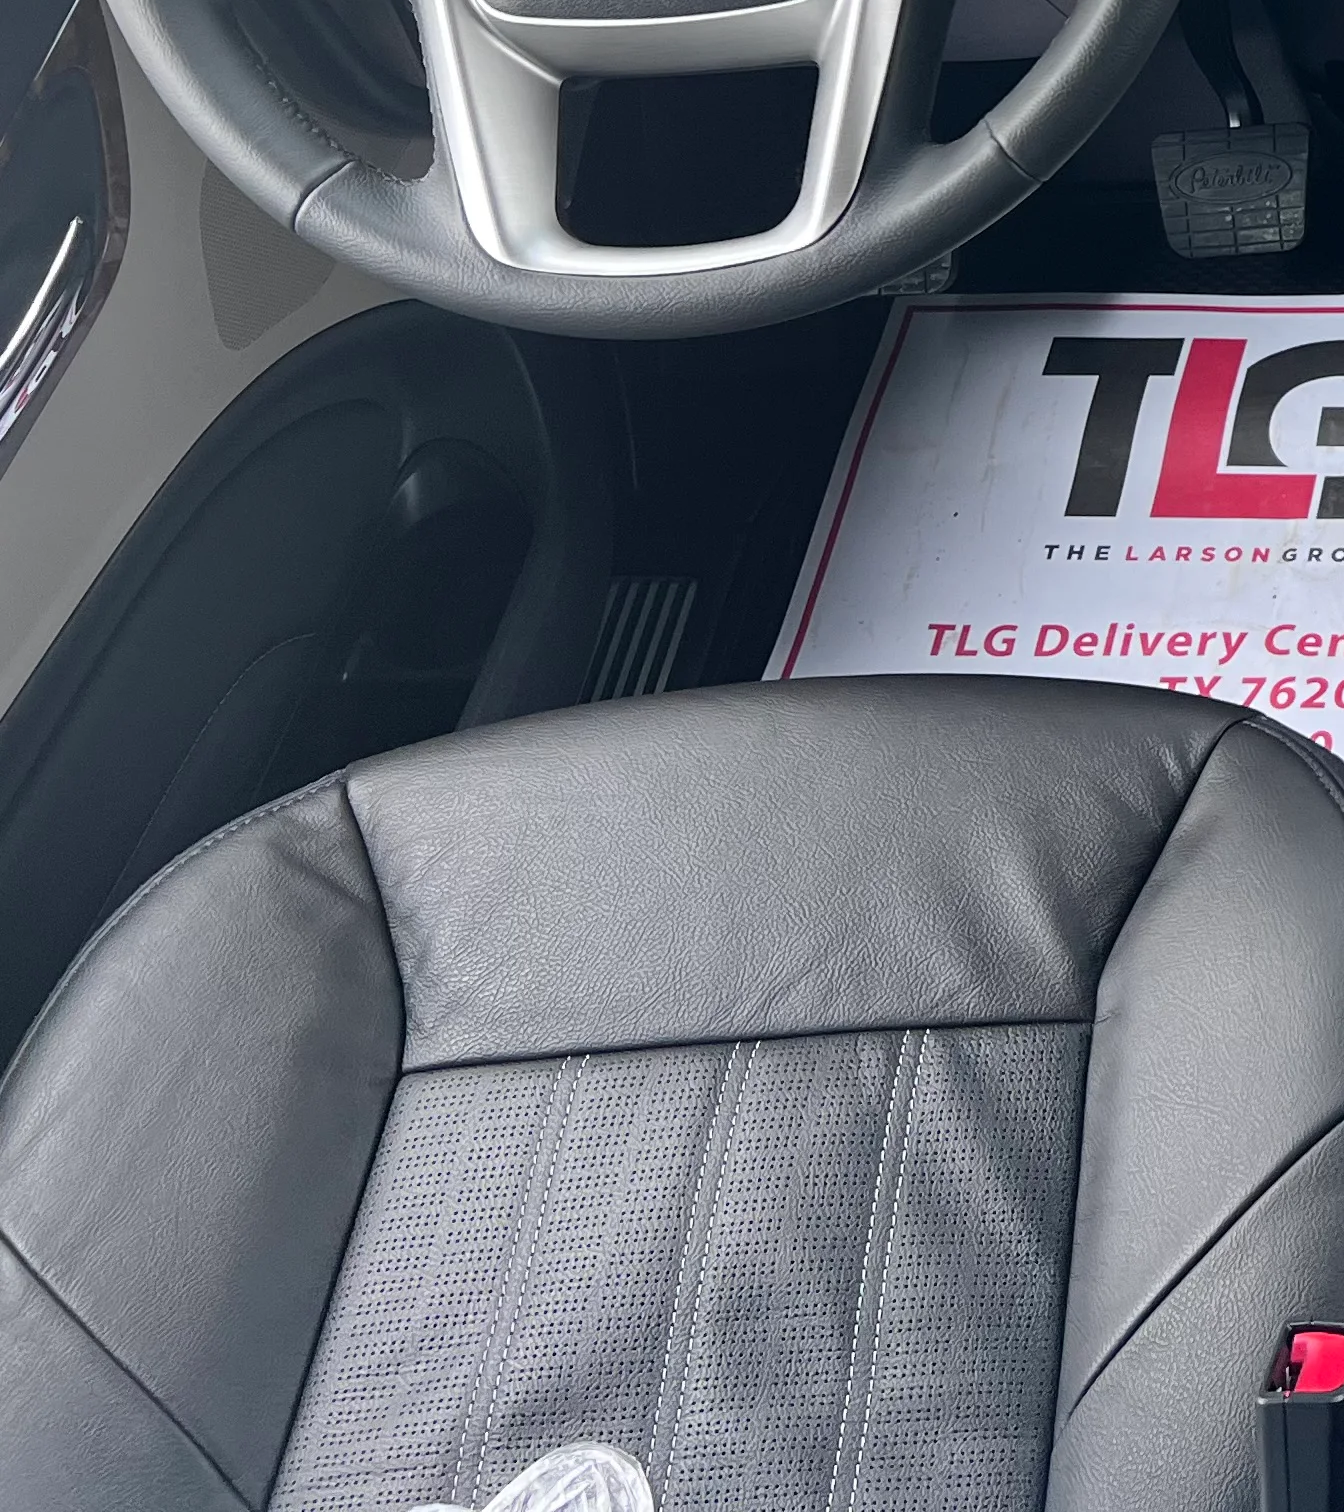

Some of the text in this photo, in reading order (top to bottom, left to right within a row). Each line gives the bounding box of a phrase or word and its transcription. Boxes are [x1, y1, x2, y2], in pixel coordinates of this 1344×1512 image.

[1189, 163, 1281, 194] Peterbilt
[1044, 544, 1112, 562] THE
[1125, 545, 1271, 563] LARSON
[928, 623, 1017, 657] TLG
[1033, 622, 1248, 665] Delivery
